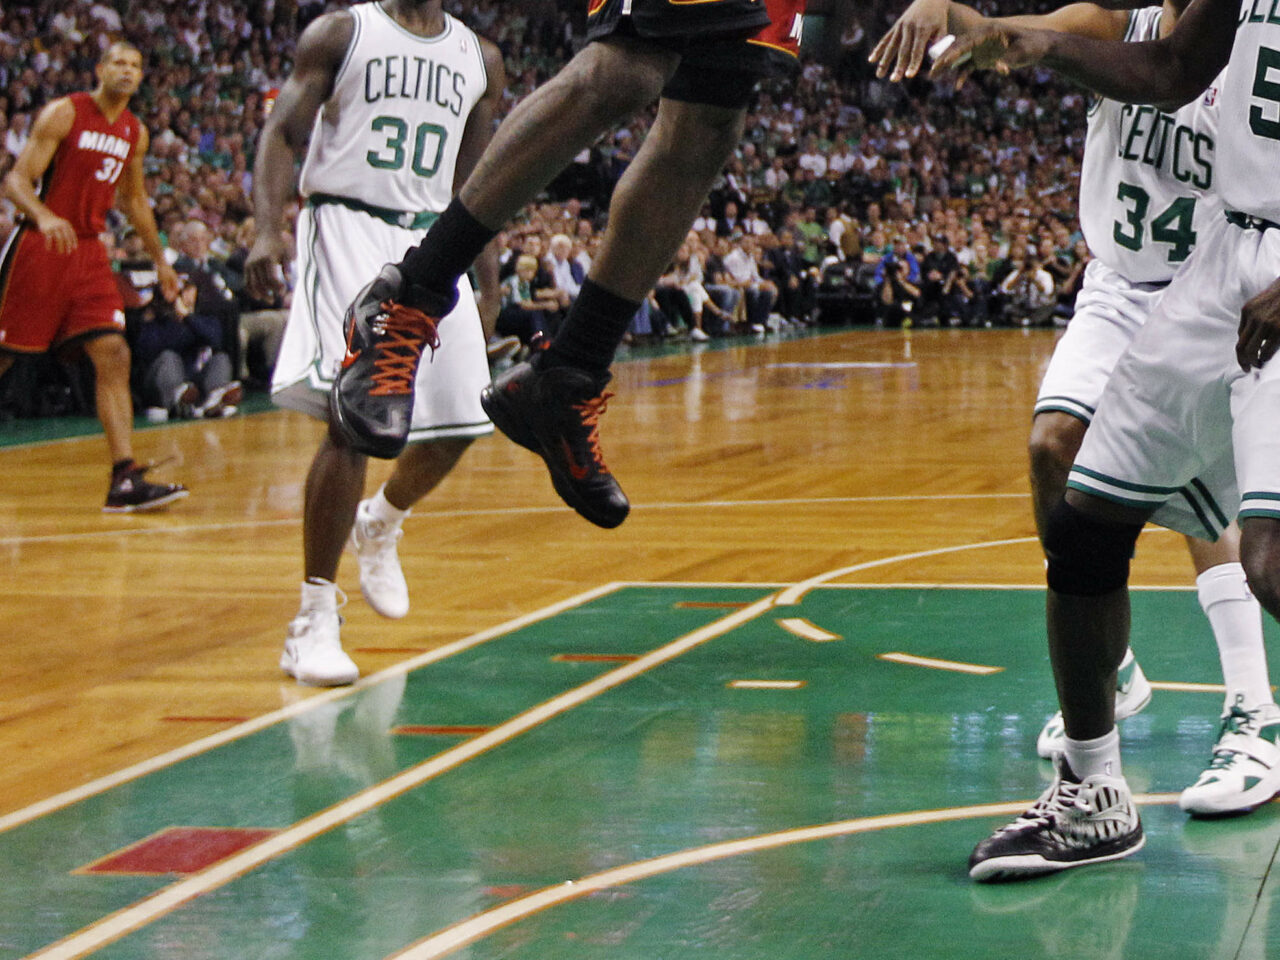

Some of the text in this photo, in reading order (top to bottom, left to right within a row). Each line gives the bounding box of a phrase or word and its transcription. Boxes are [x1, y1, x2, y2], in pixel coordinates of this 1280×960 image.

[365, 56, 466, 117] CELTICS
[95, 157, 124, 184] 31
[366, 115, 448, 178] 30
[1119, 104, 1214, 190] CELTCS
[1113, 182, 1197, 262] 34
